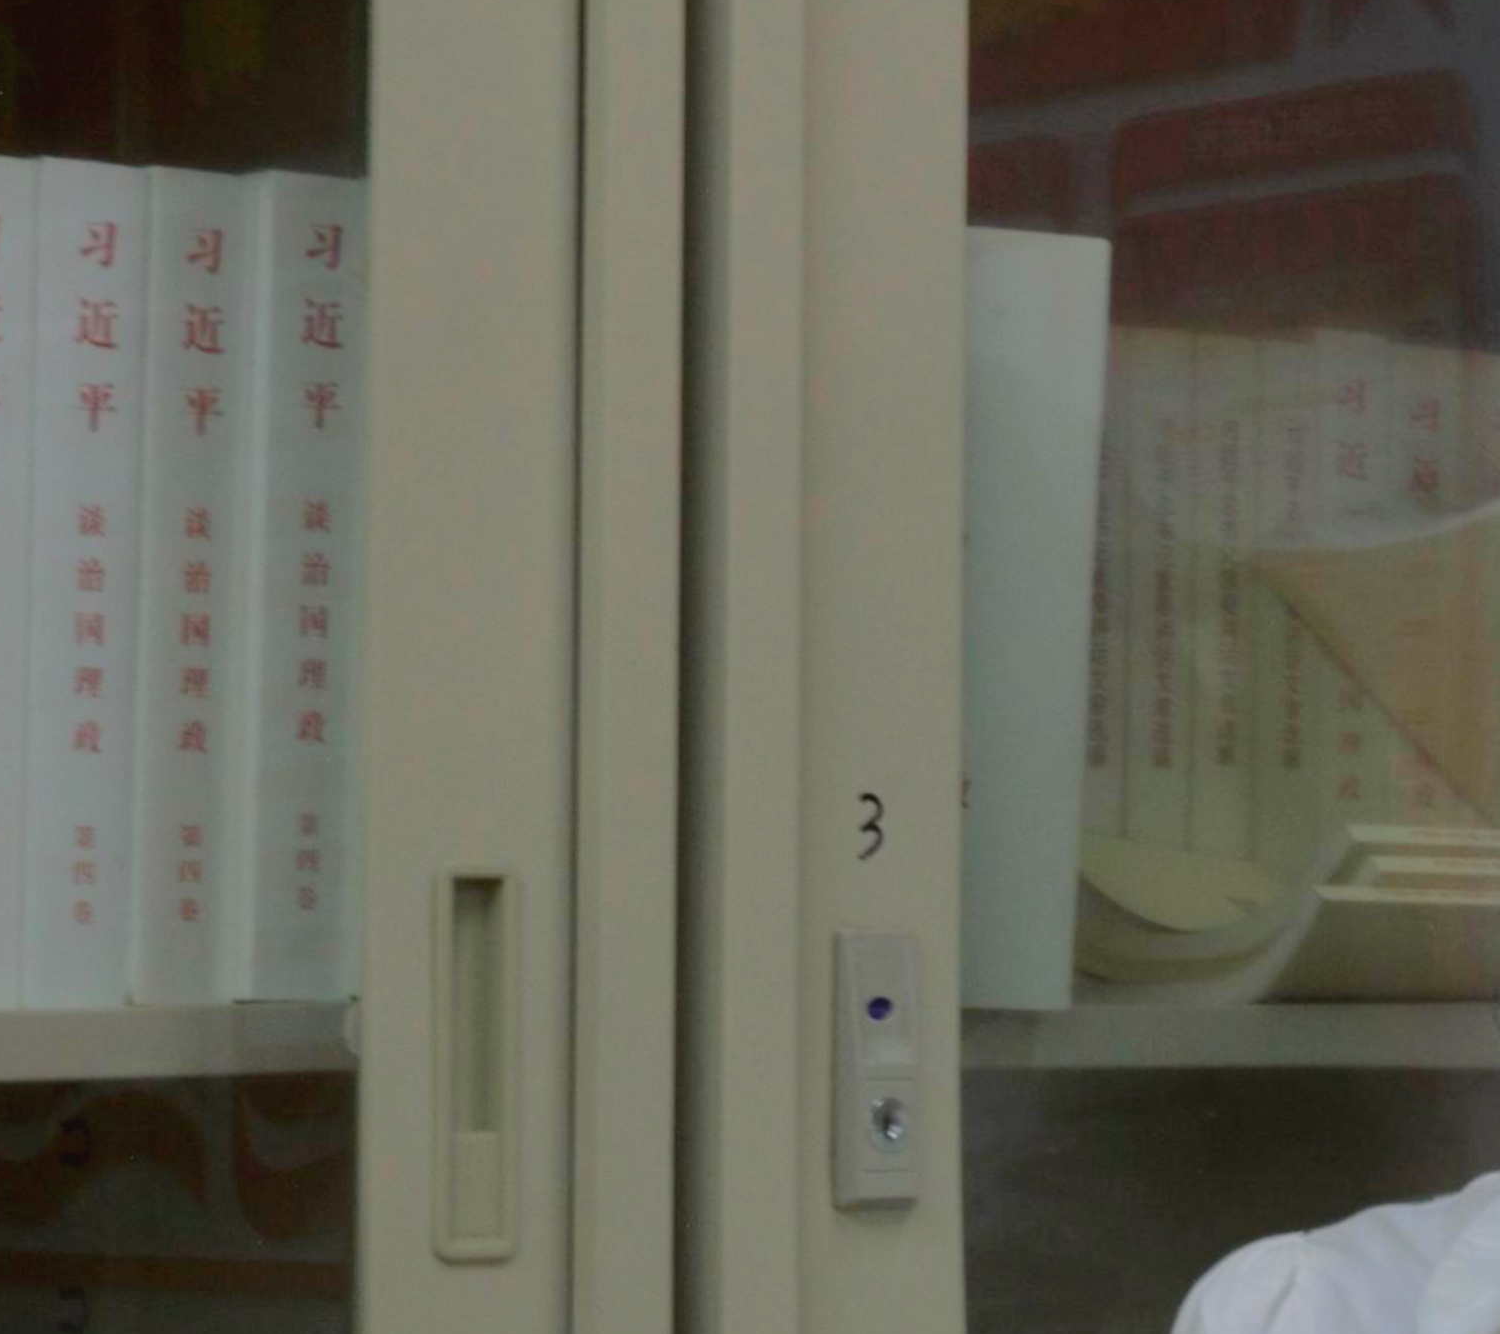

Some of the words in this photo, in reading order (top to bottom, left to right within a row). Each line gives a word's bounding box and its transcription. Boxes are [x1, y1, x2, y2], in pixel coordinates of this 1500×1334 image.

[75, 221, 120, 431] 习近平
[182, 228, 226, 437] 习近平
[301, 222, 345, 429] 习近平
[73, 505, 107, 755] 谈治国理政
[178, 507, 212, 755] 谈治国理政
[296, 500, 331, 744] 谈治国理政
[857, 792, 883, 860] 3
